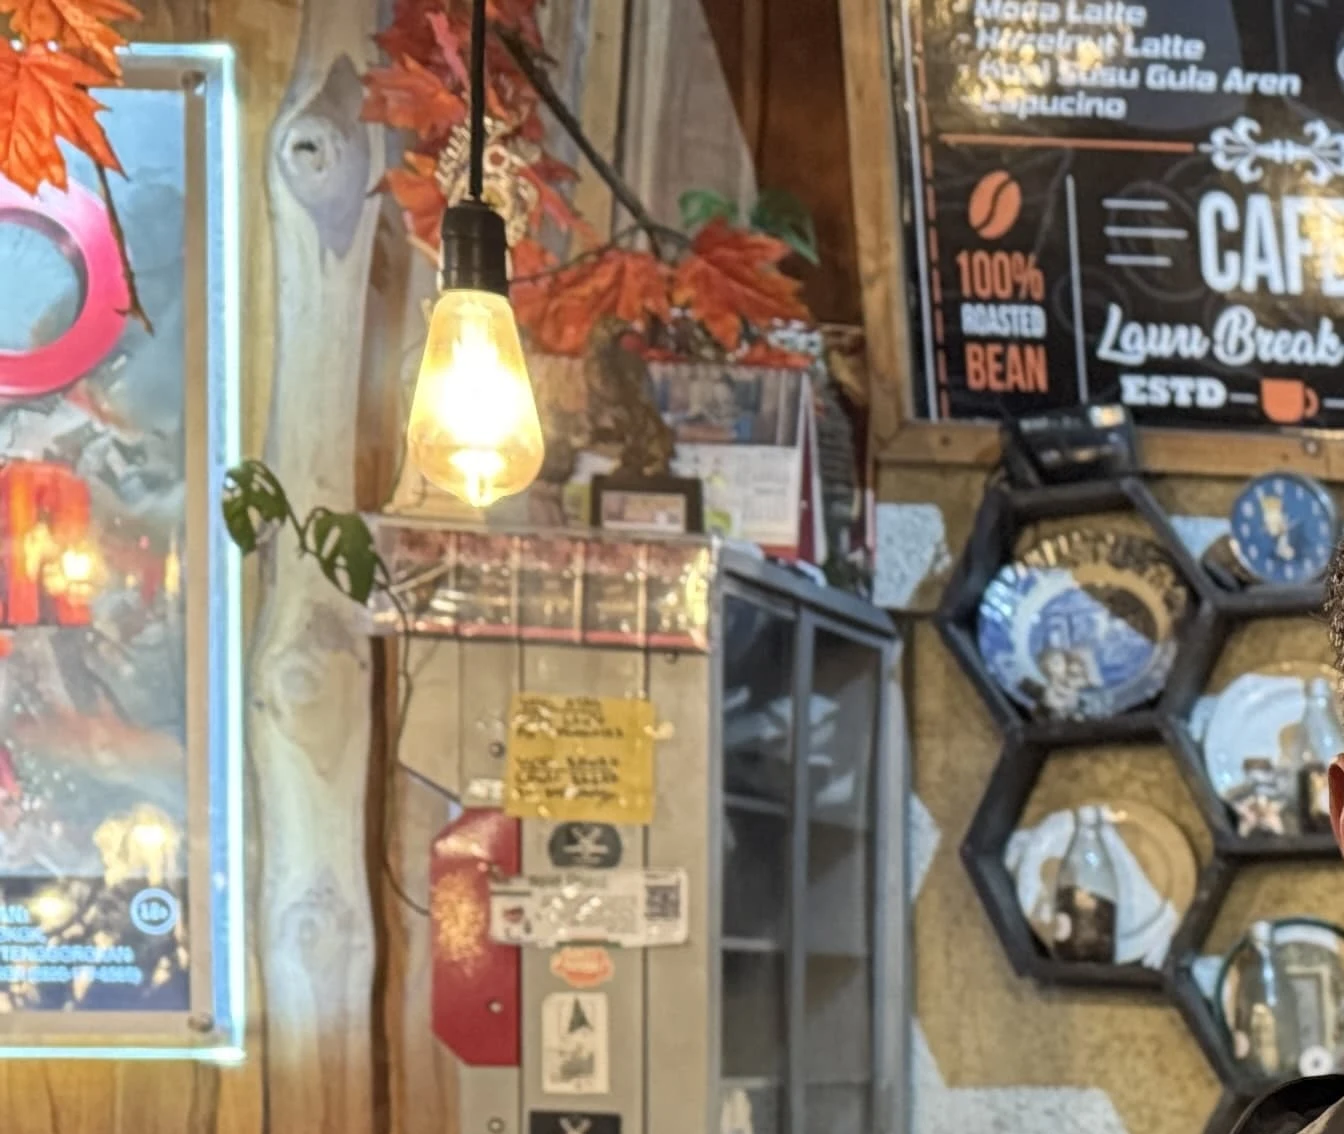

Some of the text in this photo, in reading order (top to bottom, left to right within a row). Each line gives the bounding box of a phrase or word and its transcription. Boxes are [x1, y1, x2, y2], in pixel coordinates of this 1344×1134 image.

[1065, 0, 1147, 26] Latte
[1124, 30, 1206, 61] Latte
[1145, 64, 1218, 92] Gula
[1223, 67, 1302, 95] Aren
[957, 250, 1045, 300] 100%
[960, 303, 1047, 338] ROASTED
[1097, 303, 1209, 365] Lawu
[965, 343, 1048, 393] BEAN
[1120, 374, 1227, 408] ESTD
